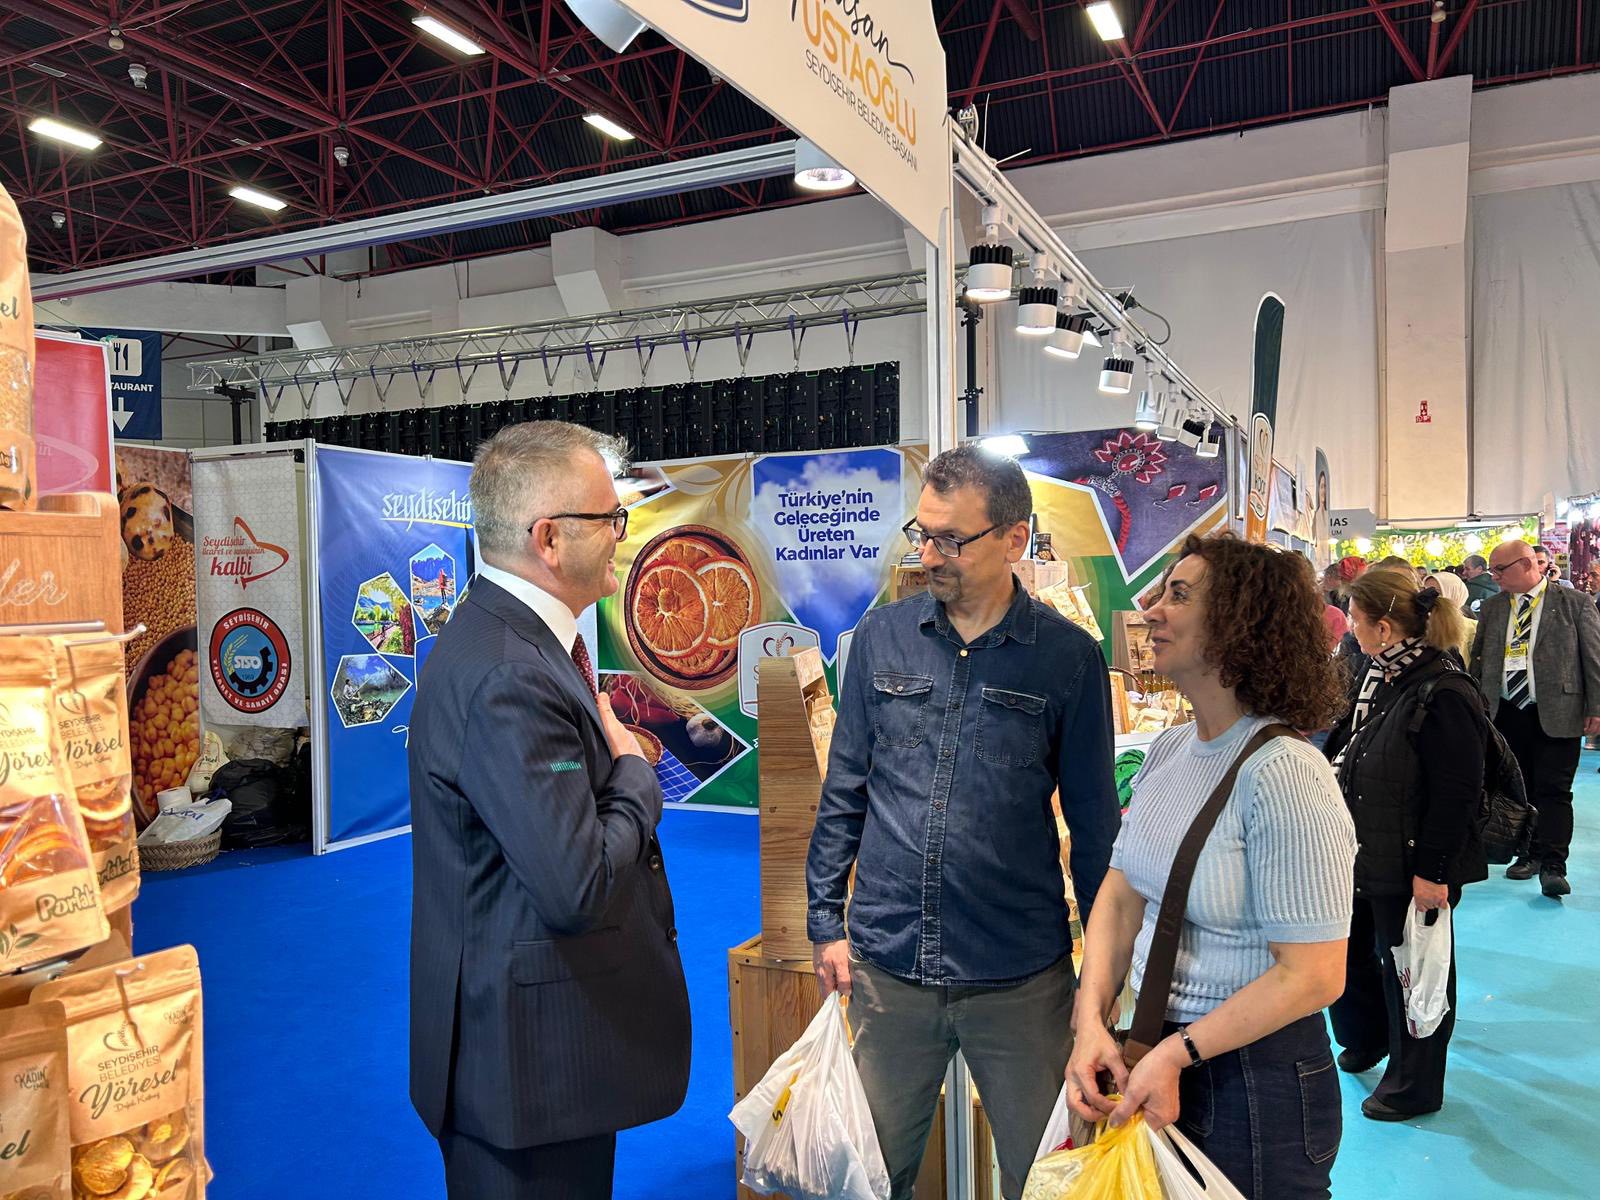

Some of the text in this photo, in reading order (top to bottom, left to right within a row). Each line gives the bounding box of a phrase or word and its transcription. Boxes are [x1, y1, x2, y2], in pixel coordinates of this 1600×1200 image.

[774, 507, 880, 526] Geleceğinde
[798, 525, 855, 543] Üreten
[776, 544, 880, 561] Kadınlar Var
[210, 556, 253, 576] kalbi
[79, 1059, 179, 1120] Yöresel
